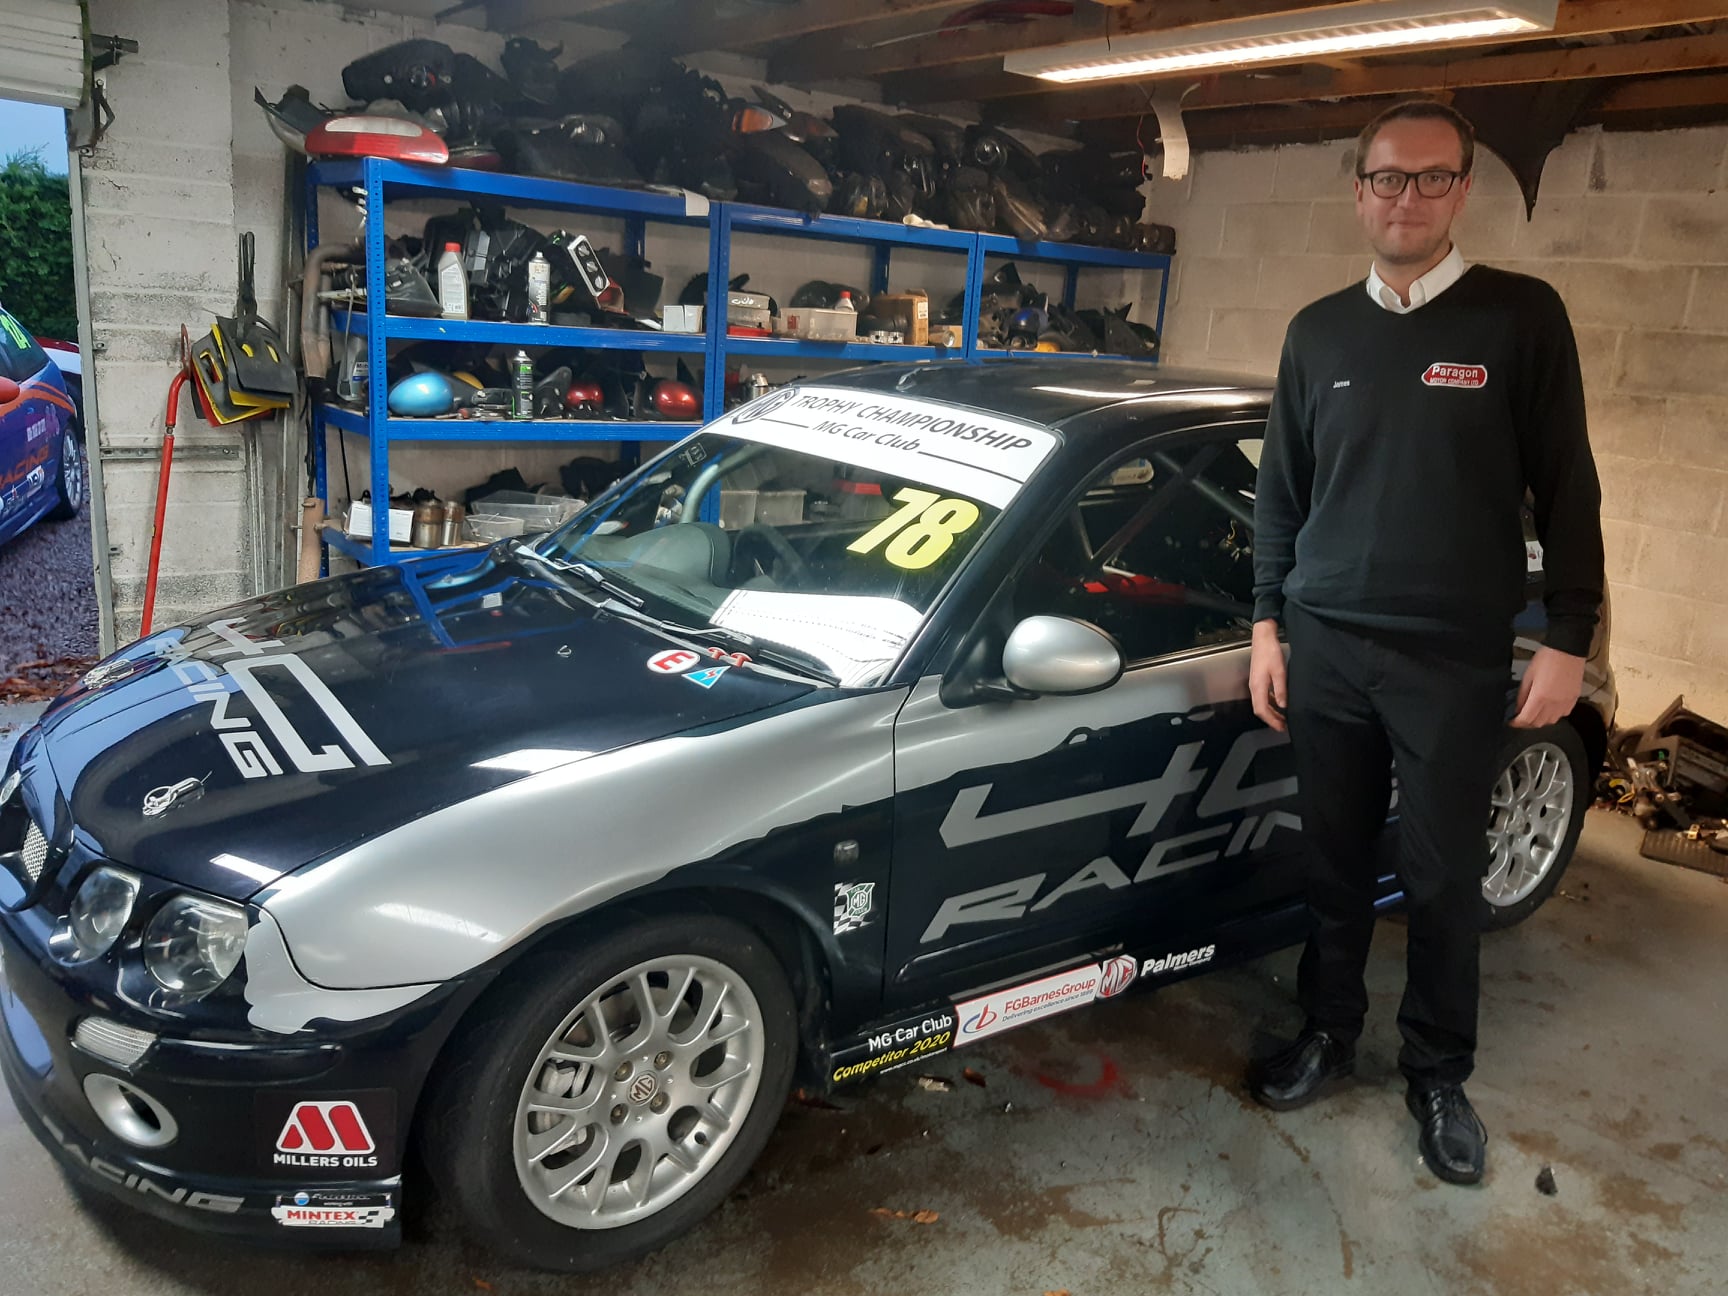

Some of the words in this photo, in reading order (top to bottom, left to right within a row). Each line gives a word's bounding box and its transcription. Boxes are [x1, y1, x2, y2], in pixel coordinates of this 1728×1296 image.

[1431, 365, 1478, 379] Paragon
[790, 395, 863, 415] TROPHY
[856, 405, 1033, 451] CHAMPIONSHIP
[812, 420, 848, 435] MG
[843, 427, 878, 441] Car
[874, 433, 920, 451] Club
[846, 487, 980, 569] 78
[653, 651, 695, 670] E
[920, 810, 1303, 943] RACIN
[853, 892, 866, 908] MG
[1099, 957, 1135, 995] MG
[1140, 944, 1216, 977] Palmers
[1004, 978, 1096, 1014] FGBarnesGroup
[868, 1032, 893, 1052] MG
[895, 1025, 919, 1043] Car
[921, 1014, 953, 1034] Club
[832, 1047, 909, 1083] Competitor
[909, 1030, 951, 1055] 2020
[633, 1077, 653, 1099] MG
[273, 1153, 340, 1167] MILLERS
[342, 1156, 378, 1168] OILS
[287, 1210, 356, 1221] MINTEX
